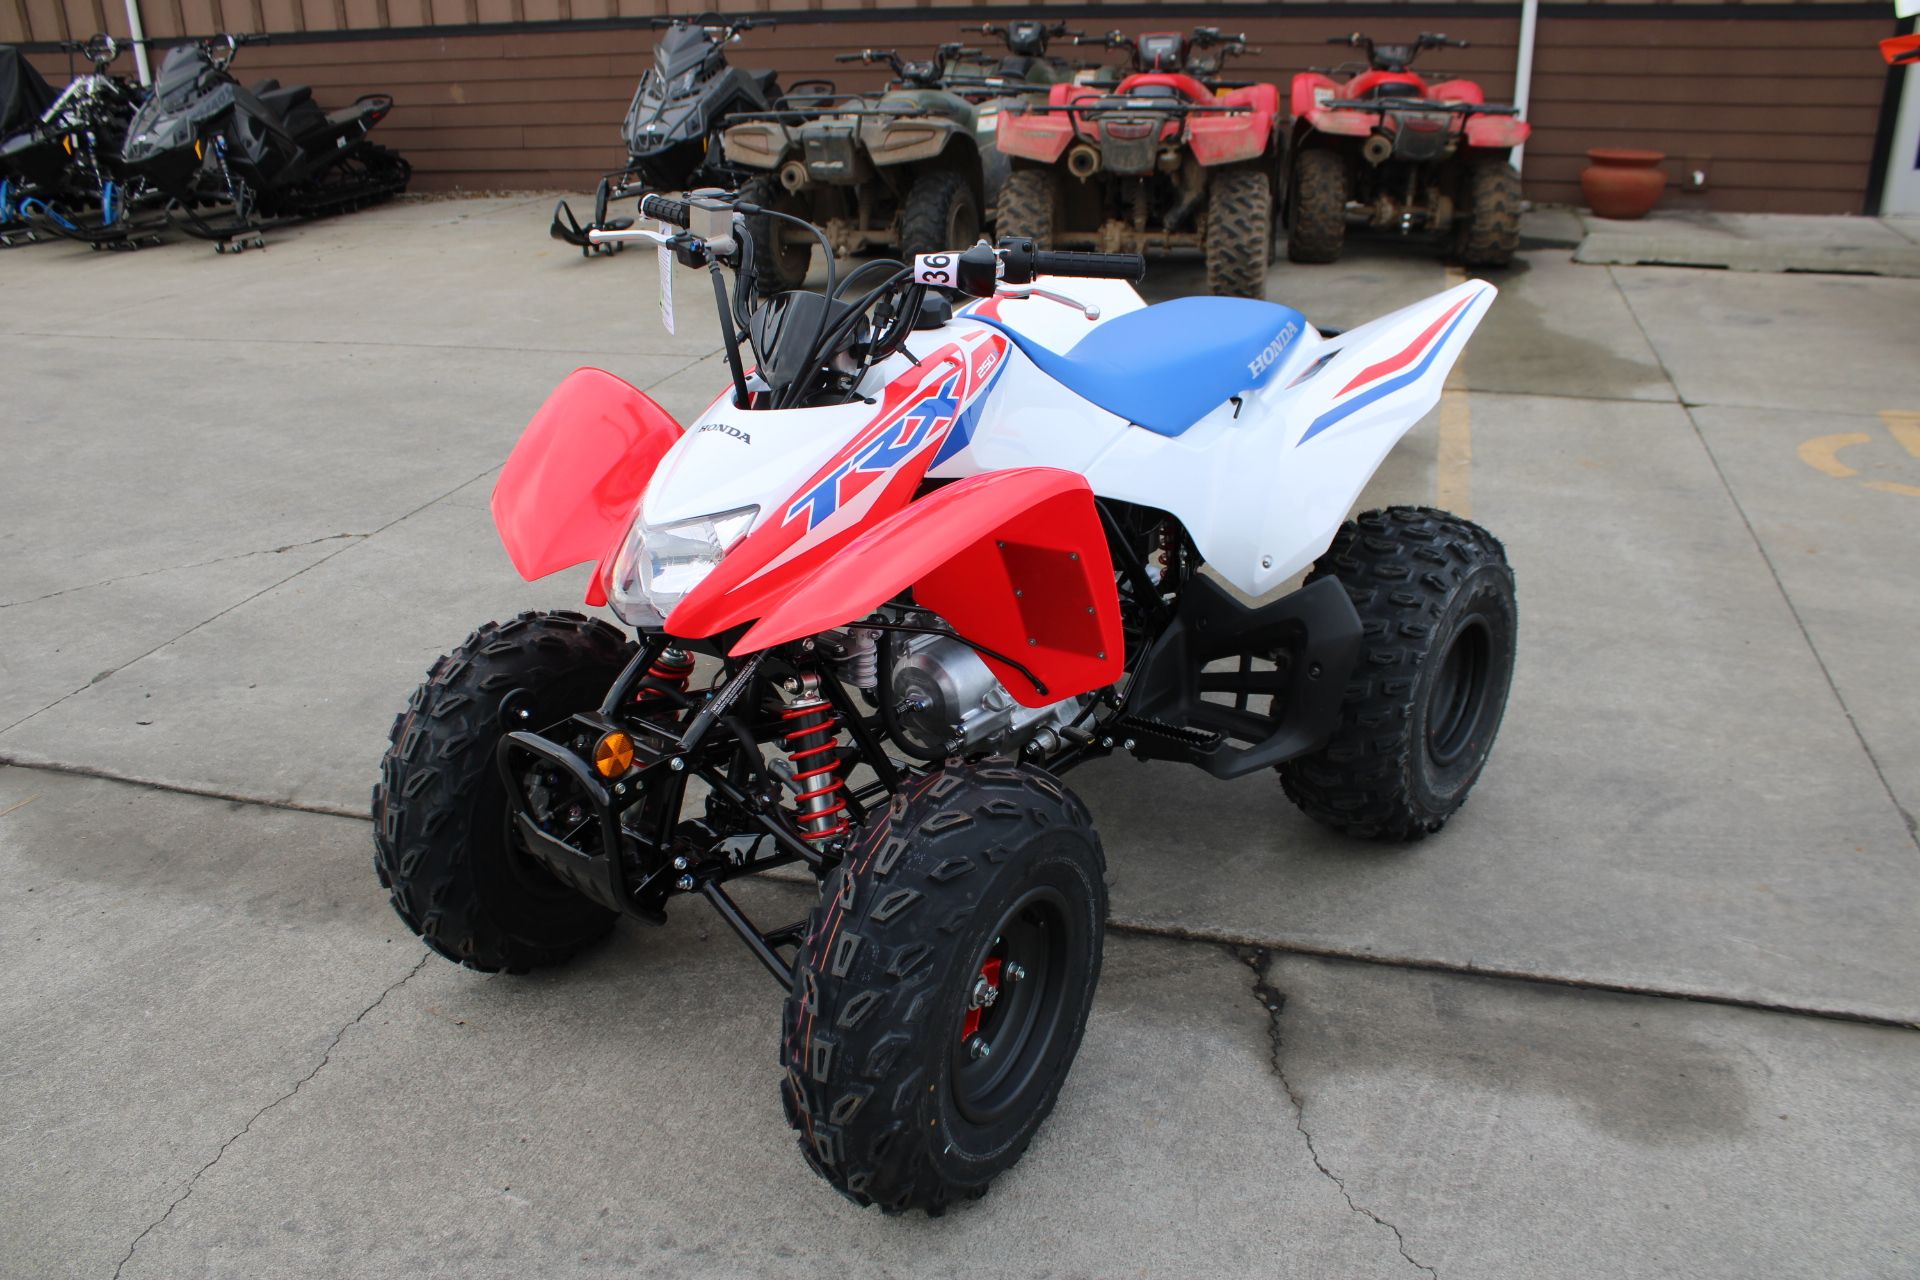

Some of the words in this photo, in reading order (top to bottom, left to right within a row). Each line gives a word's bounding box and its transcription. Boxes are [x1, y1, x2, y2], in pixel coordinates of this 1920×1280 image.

[922, 255, 951, 283] 36
[1247, 320, 1298, 380] HONDA
[976, 352, 997, 379] 250
[697, 423, 751, 445] HONDA
[783, 369, 962, 532] TRX
